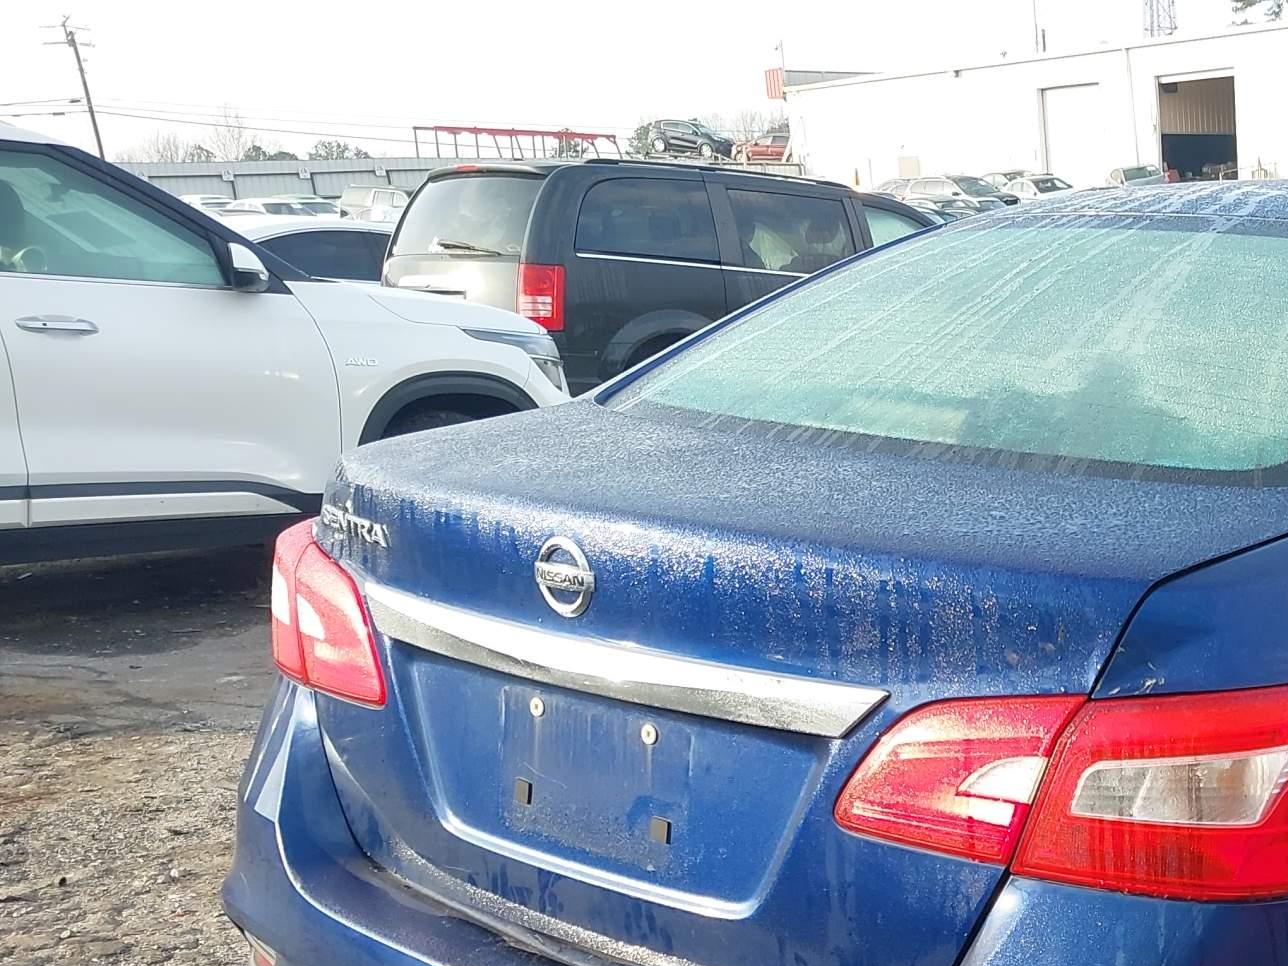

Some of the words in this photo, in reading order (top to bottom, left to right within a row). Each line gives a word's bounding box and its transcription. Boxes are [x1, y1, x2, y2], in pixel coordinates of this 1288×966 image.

[344, 357, 378, 367] AWD
[321, 503, 392, 549] SENTRA
[536, 567, 585, 587] NISSAN
